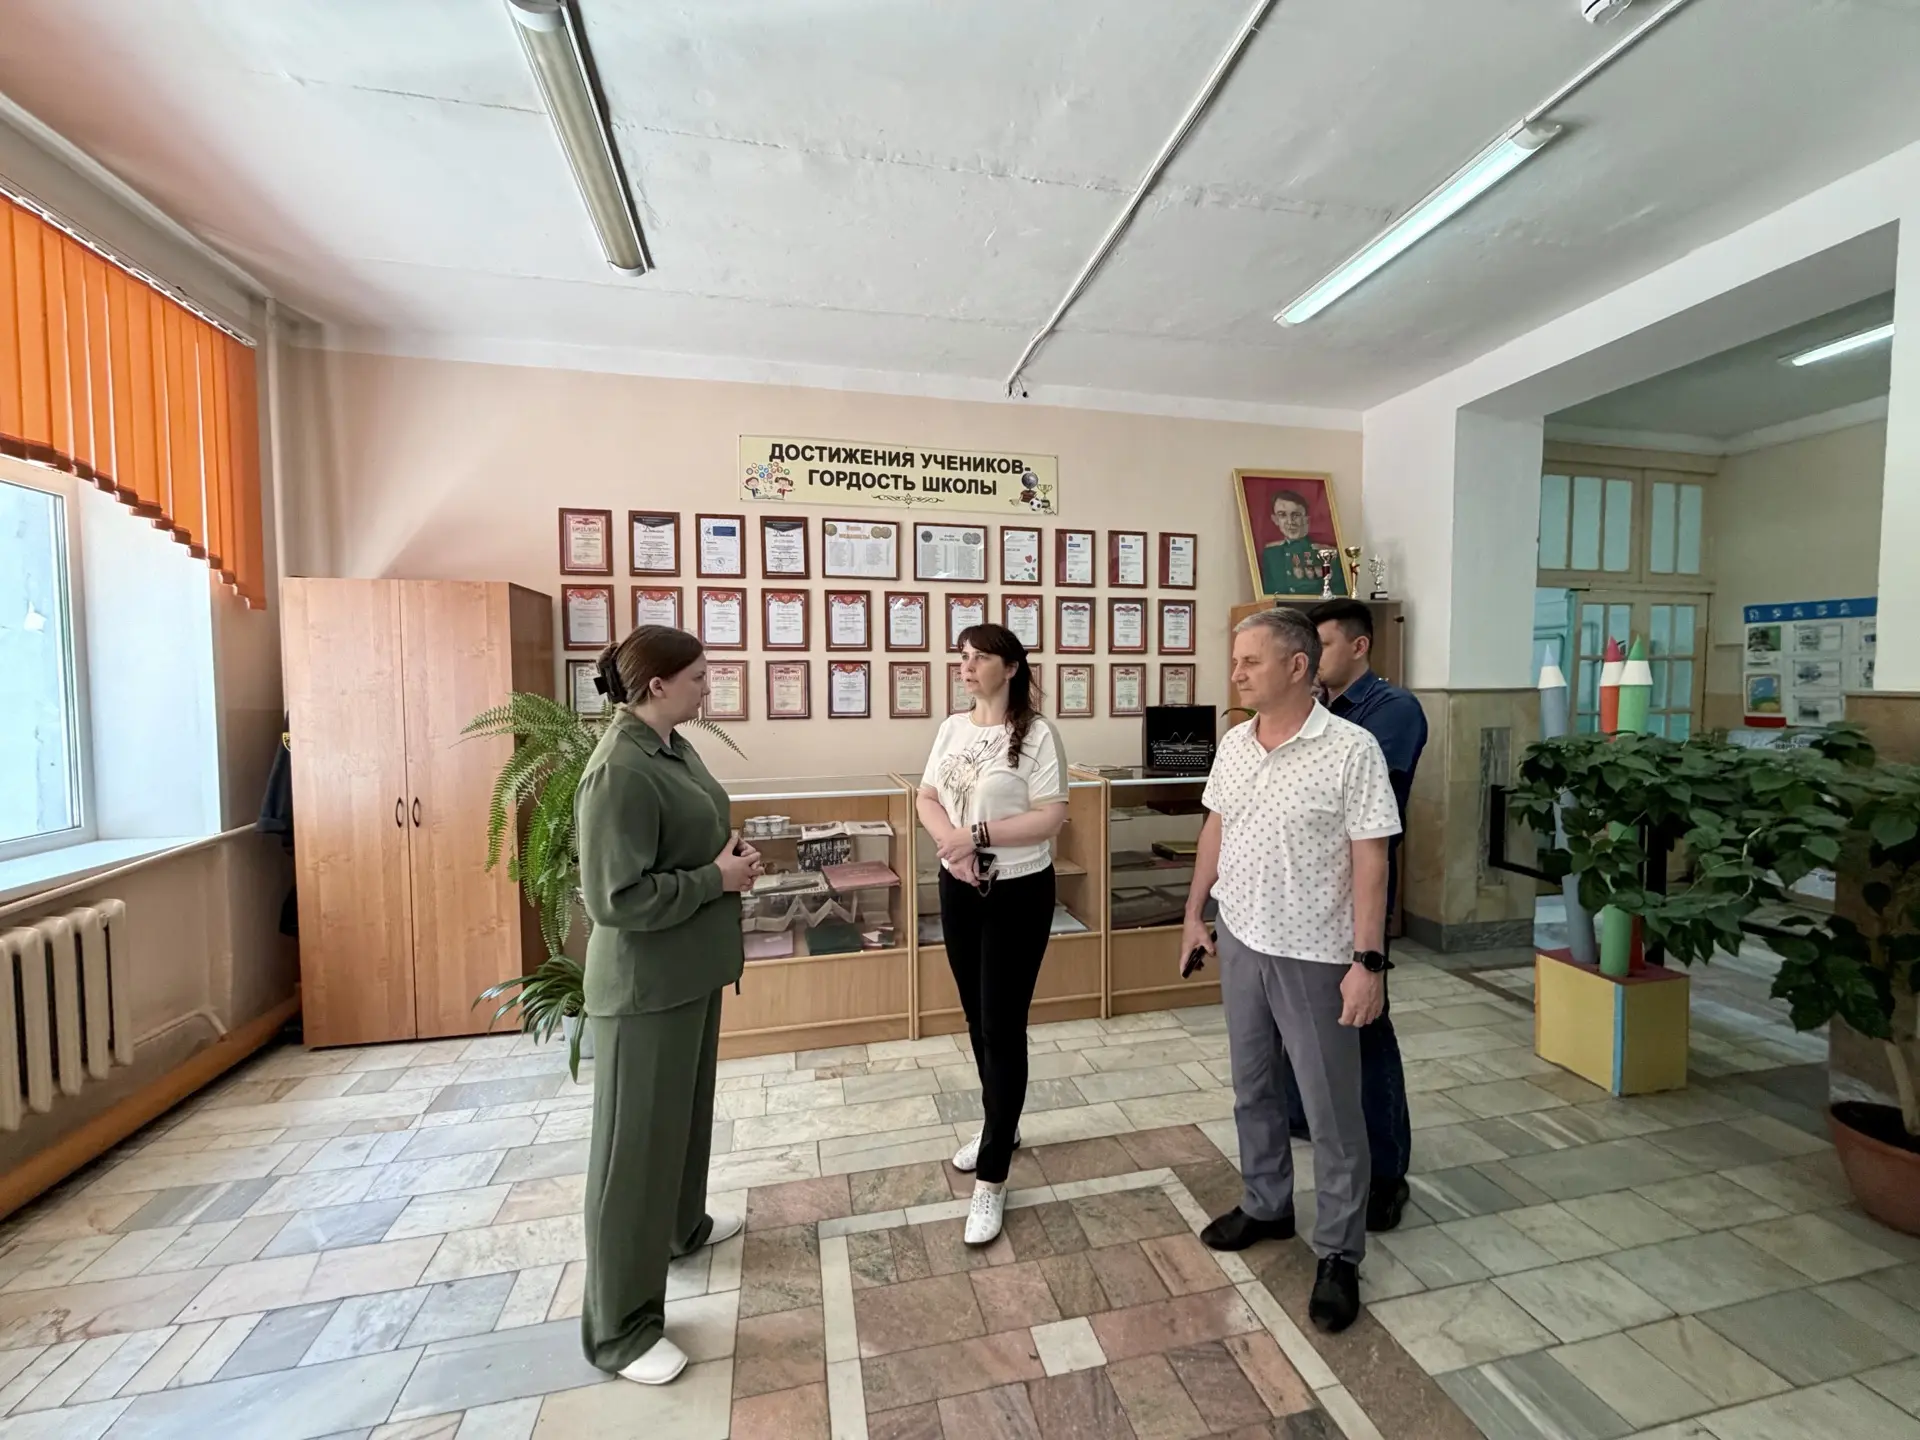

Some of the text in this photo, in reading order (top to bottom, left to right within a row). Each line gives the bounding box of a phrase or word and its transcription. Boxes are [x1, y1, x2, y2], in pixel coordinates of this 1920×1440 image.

[769, 443, 915, 468] ДОСТИЖЕНИЯ
[808, 469, 997, 495] ГОРДОСТЬ ШКОЛЫ
